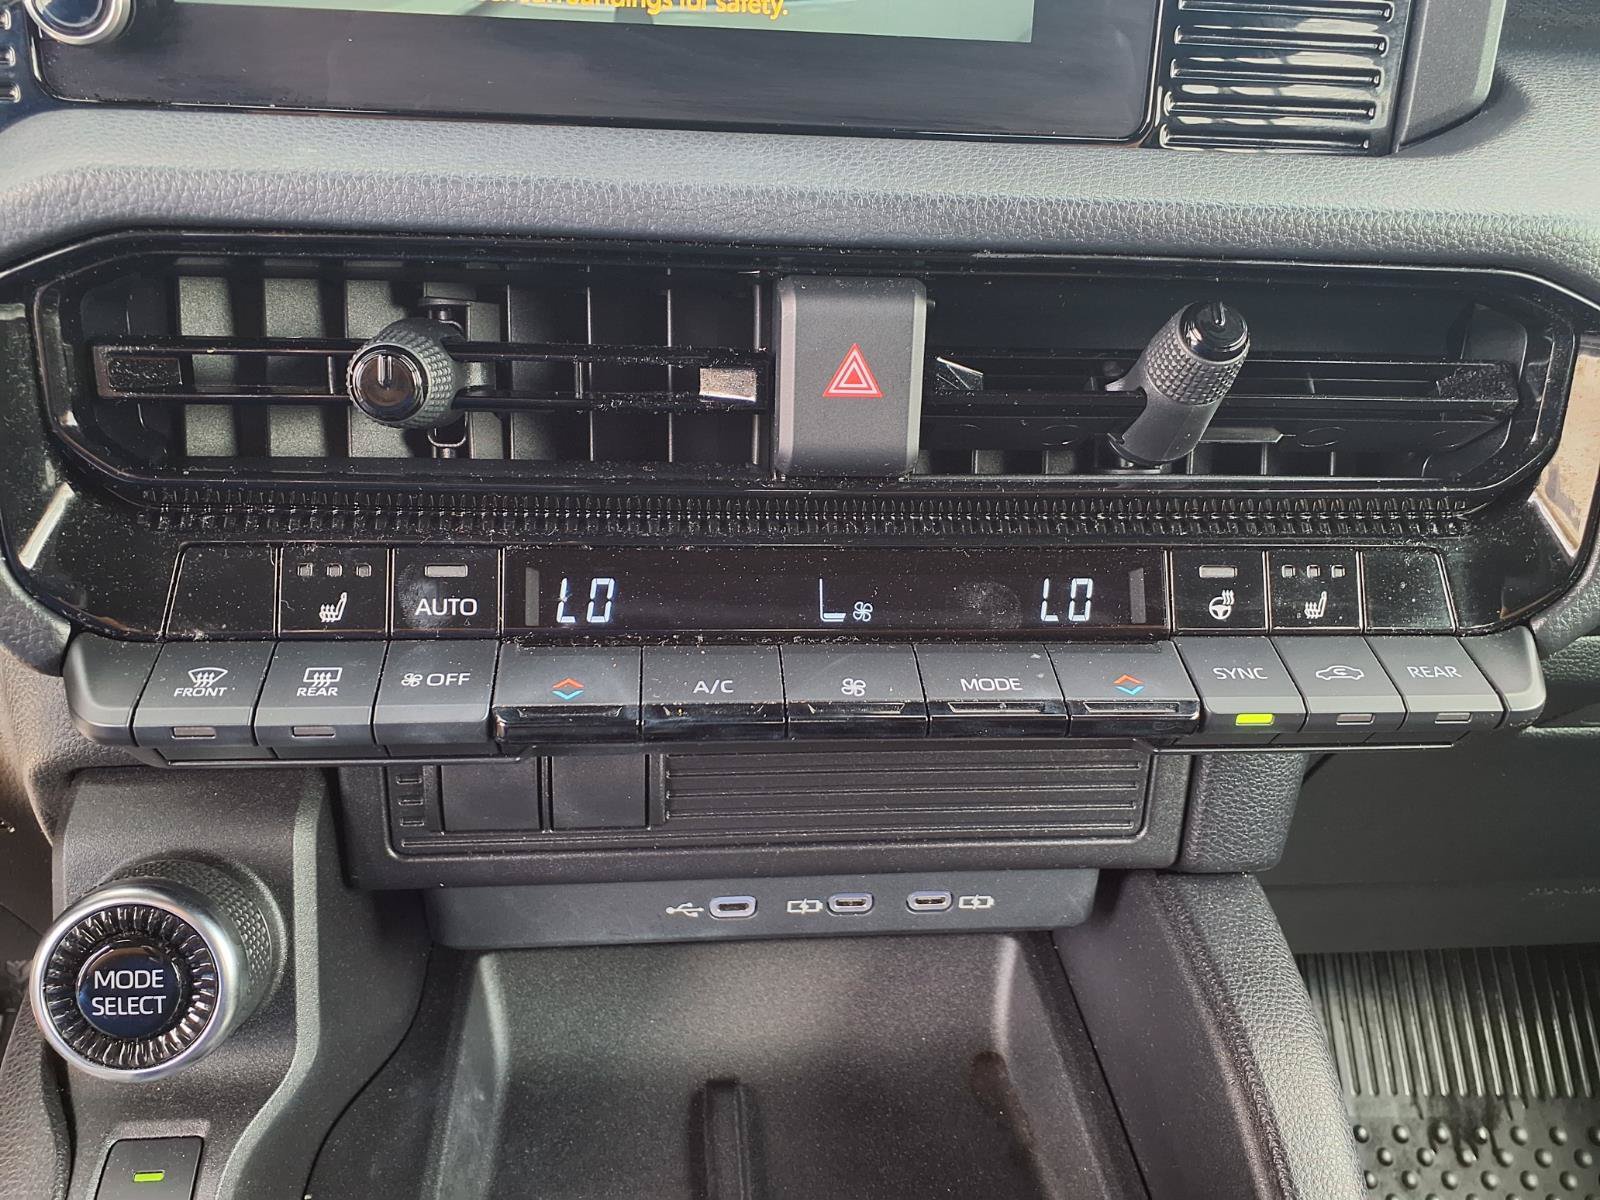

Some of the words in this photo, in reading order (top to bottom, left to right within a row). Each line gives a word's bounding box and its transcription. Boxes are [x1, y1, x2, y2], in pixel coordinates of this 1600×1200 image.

[716, 0, 788, 20] safety.
[415, 598, 477, 616] AUTO
[1213, 667, 1268, 680] SYNC
[1407, 665, 1461, 678] REAR
[426, 672, 471, 686] OFF
[961, 678, 1022, 691] MODE
[173, 687, 227, 697] FRONT
[297, 687, 338, 697] REAR
[693, 679, 734, 694] A/C
[94, 969, 164, 989] MODE
[91, 995, 166, 1015] SELECT
